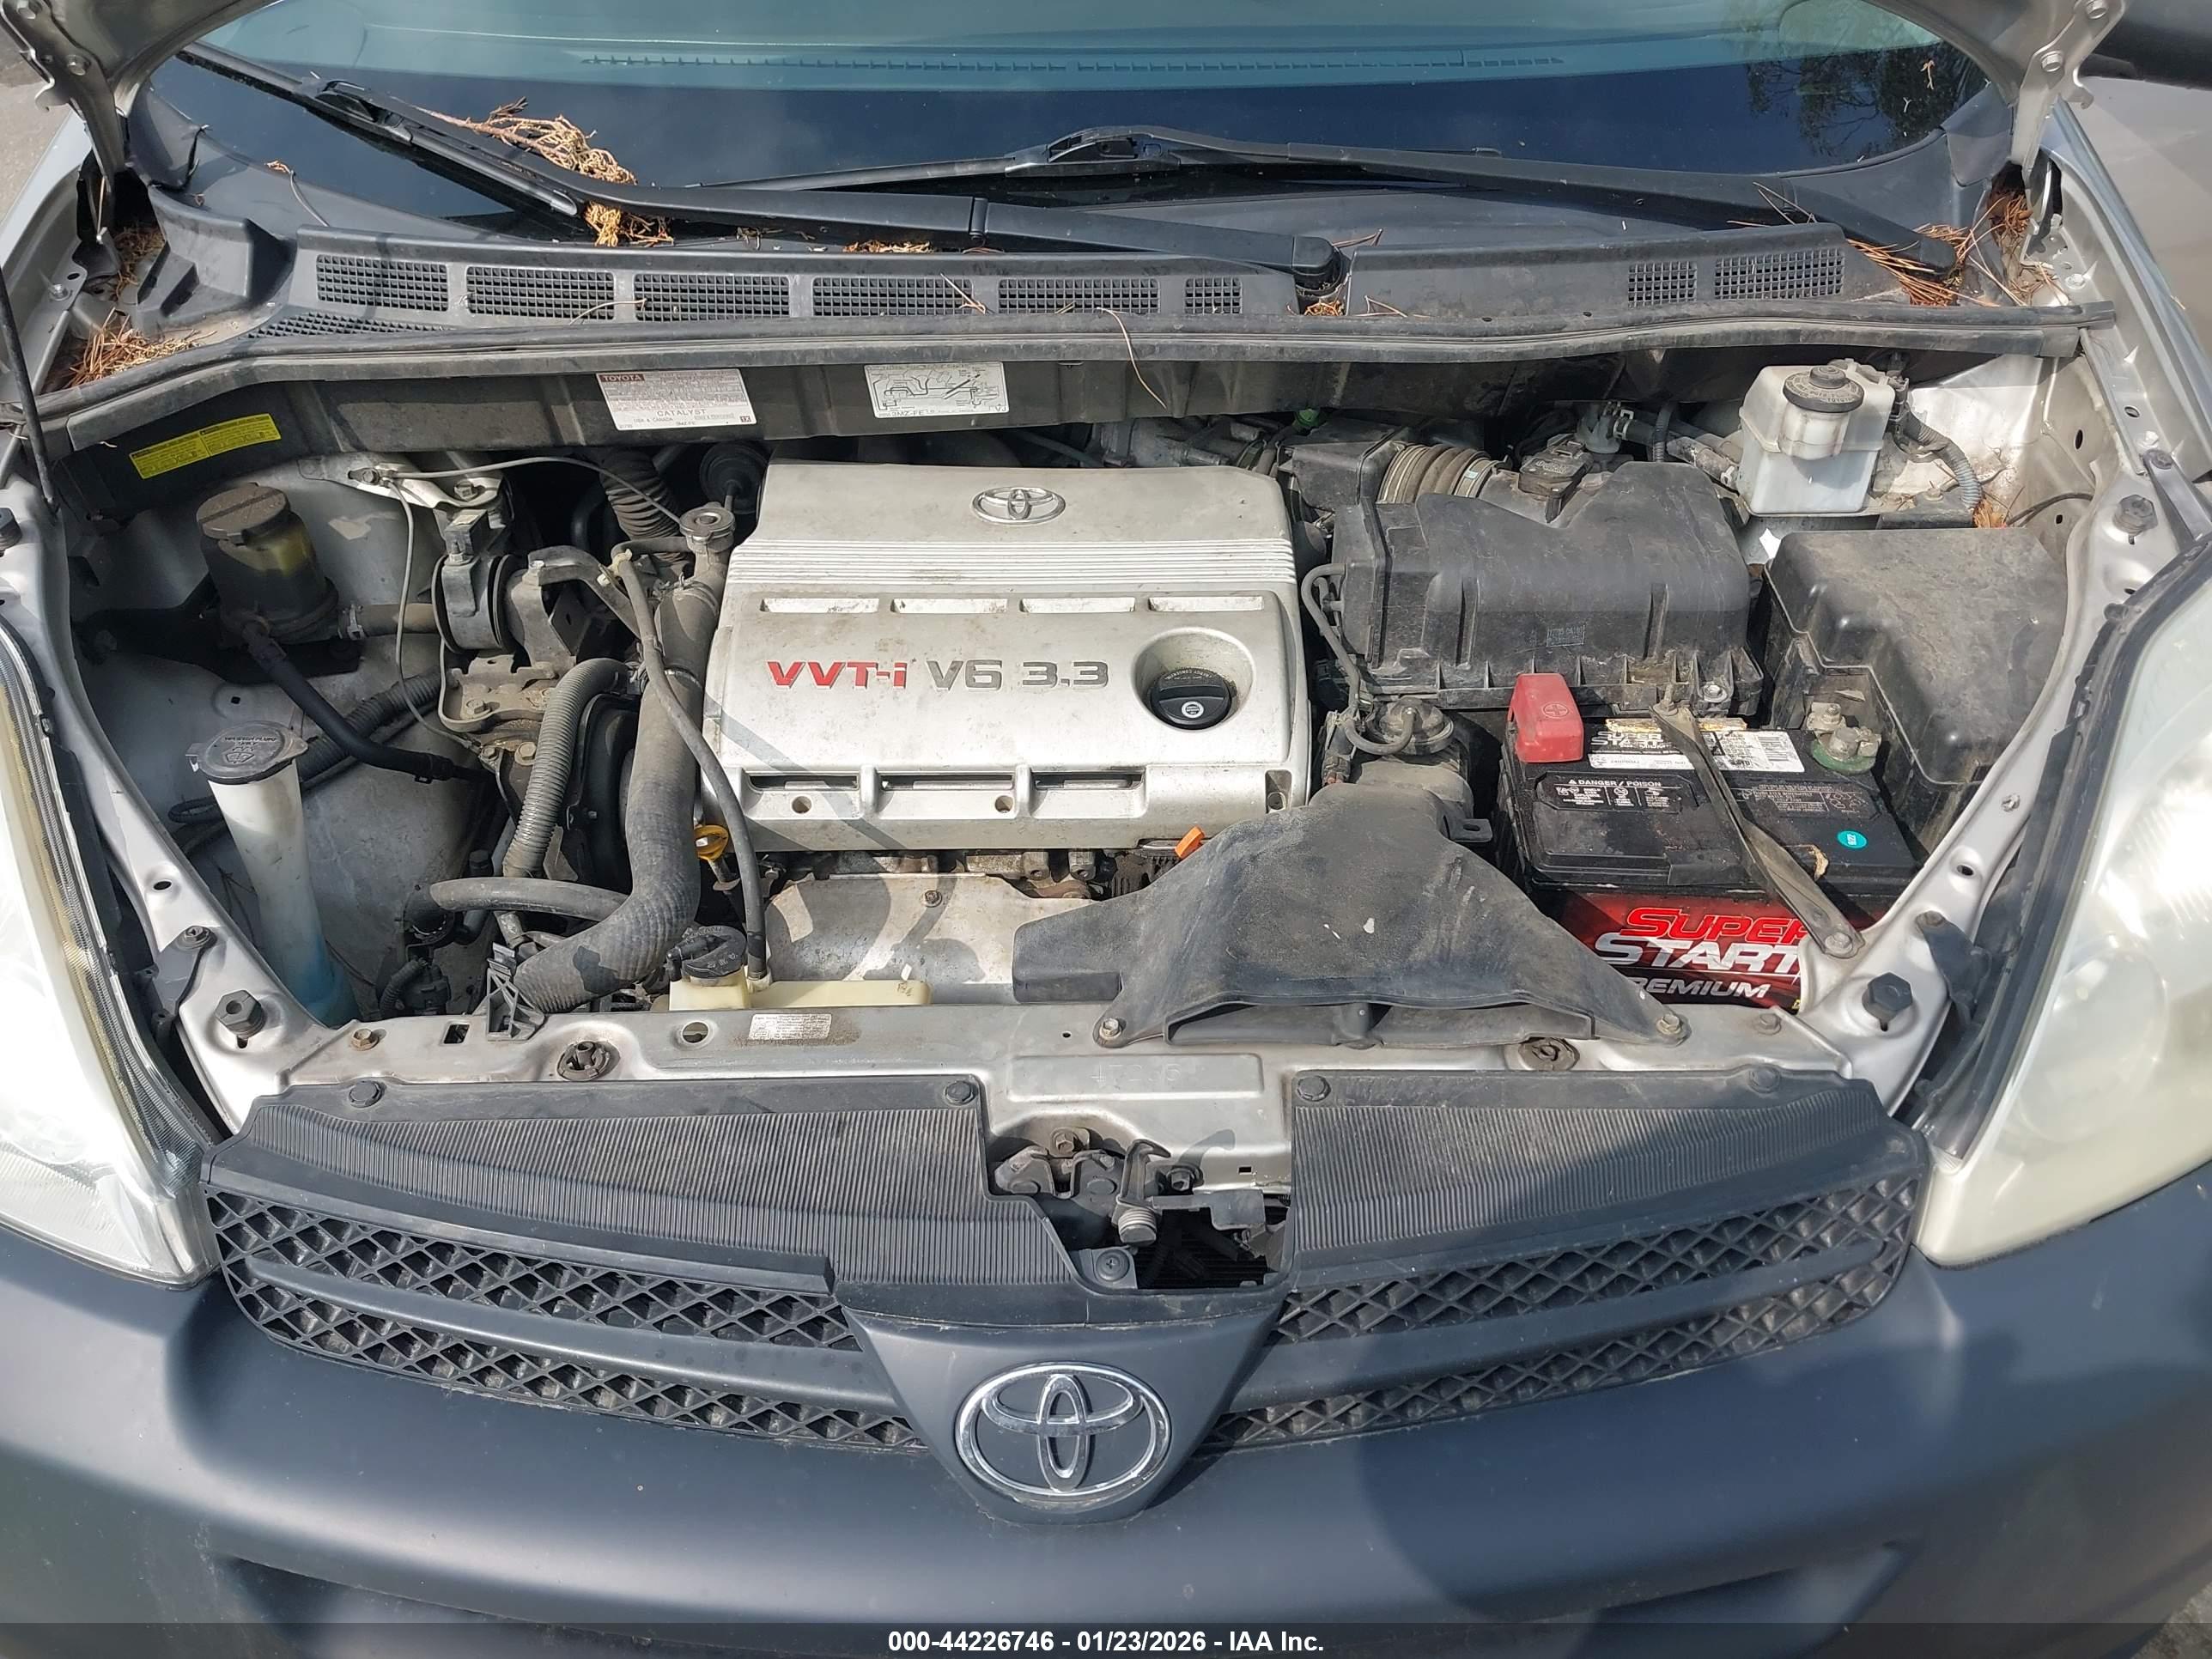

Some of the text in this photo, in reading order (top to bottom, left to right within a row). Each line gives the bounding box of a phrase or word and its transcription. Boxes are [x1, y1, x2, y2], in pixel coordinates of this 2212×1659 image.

[657, 409, 707, 417] CATALYST
[767, 659, 1110, 691] VVT-i V6 3.3
[1595, 933, 1800, 974] START
